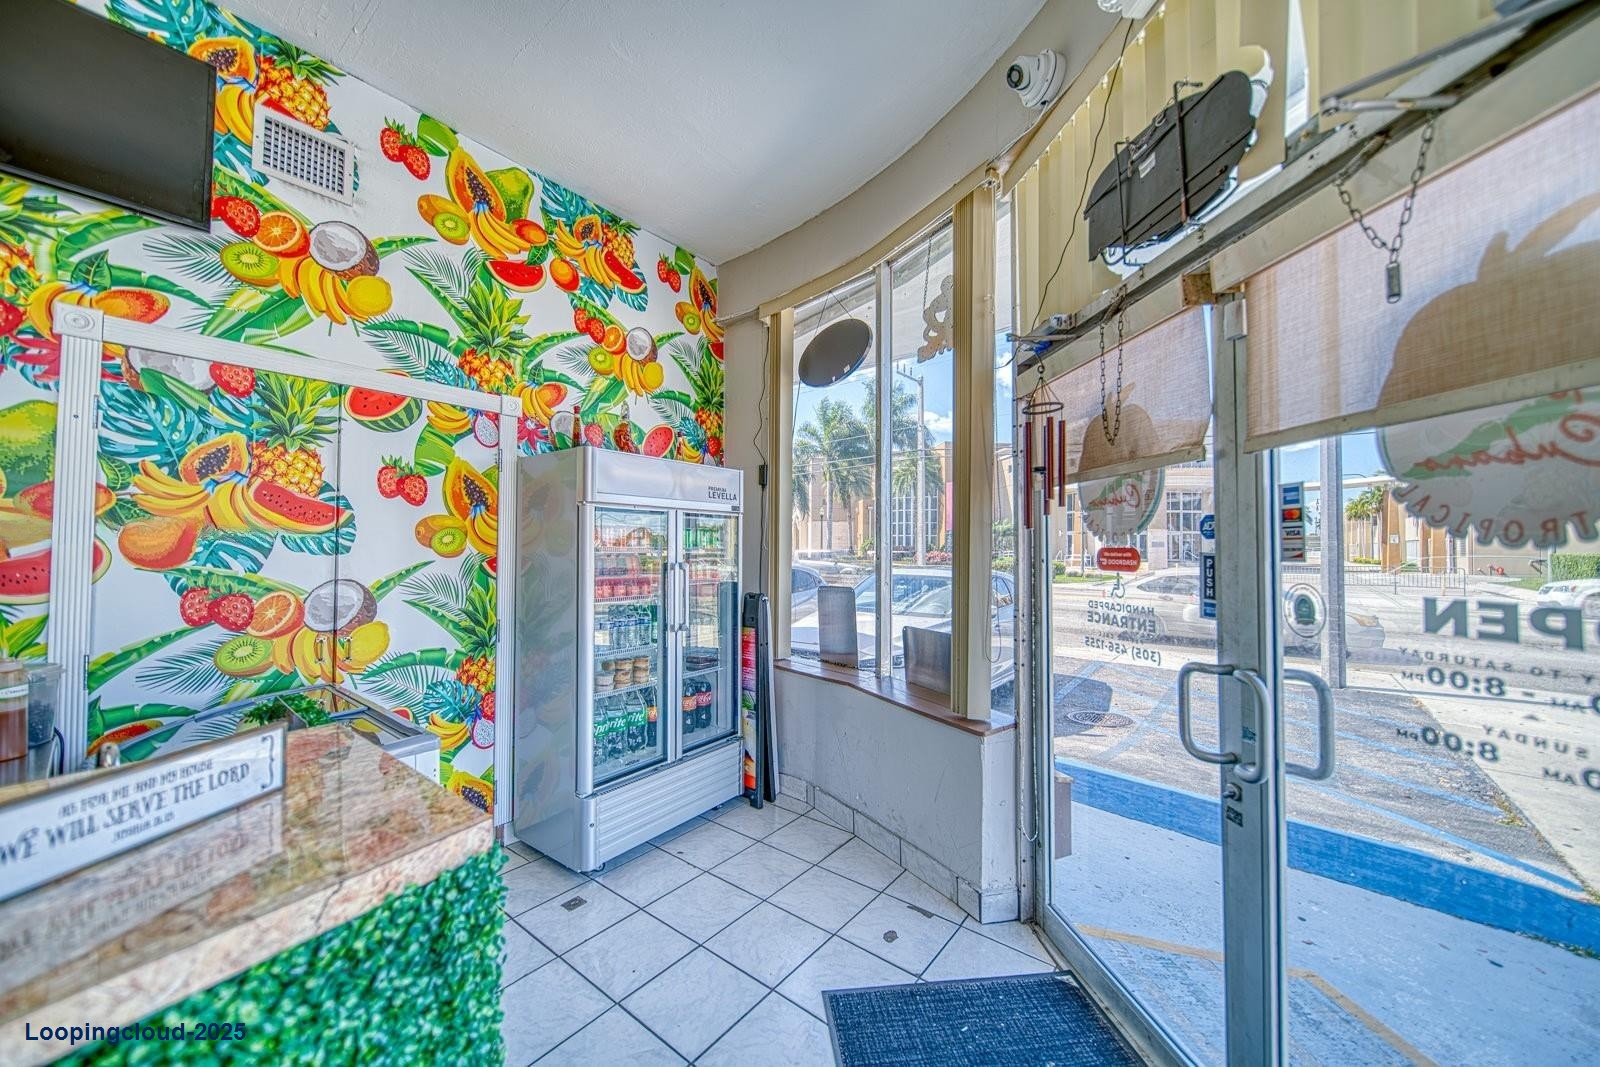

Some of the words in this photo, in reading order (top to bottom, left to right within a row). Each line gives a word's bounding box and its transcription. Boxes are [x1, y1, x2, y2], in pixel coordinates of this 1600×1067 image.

[708, 491, 737, 501] LEVELLA
[1206, 559, 1214, 596] PUSH
[0, 827, 40, 866] WE
[45, 815, 99, 848] WILL
[103, 790, 169, 829] SERVE
[174, 778, 204, 804] THE
[209, 763, 250, 792] LORD
